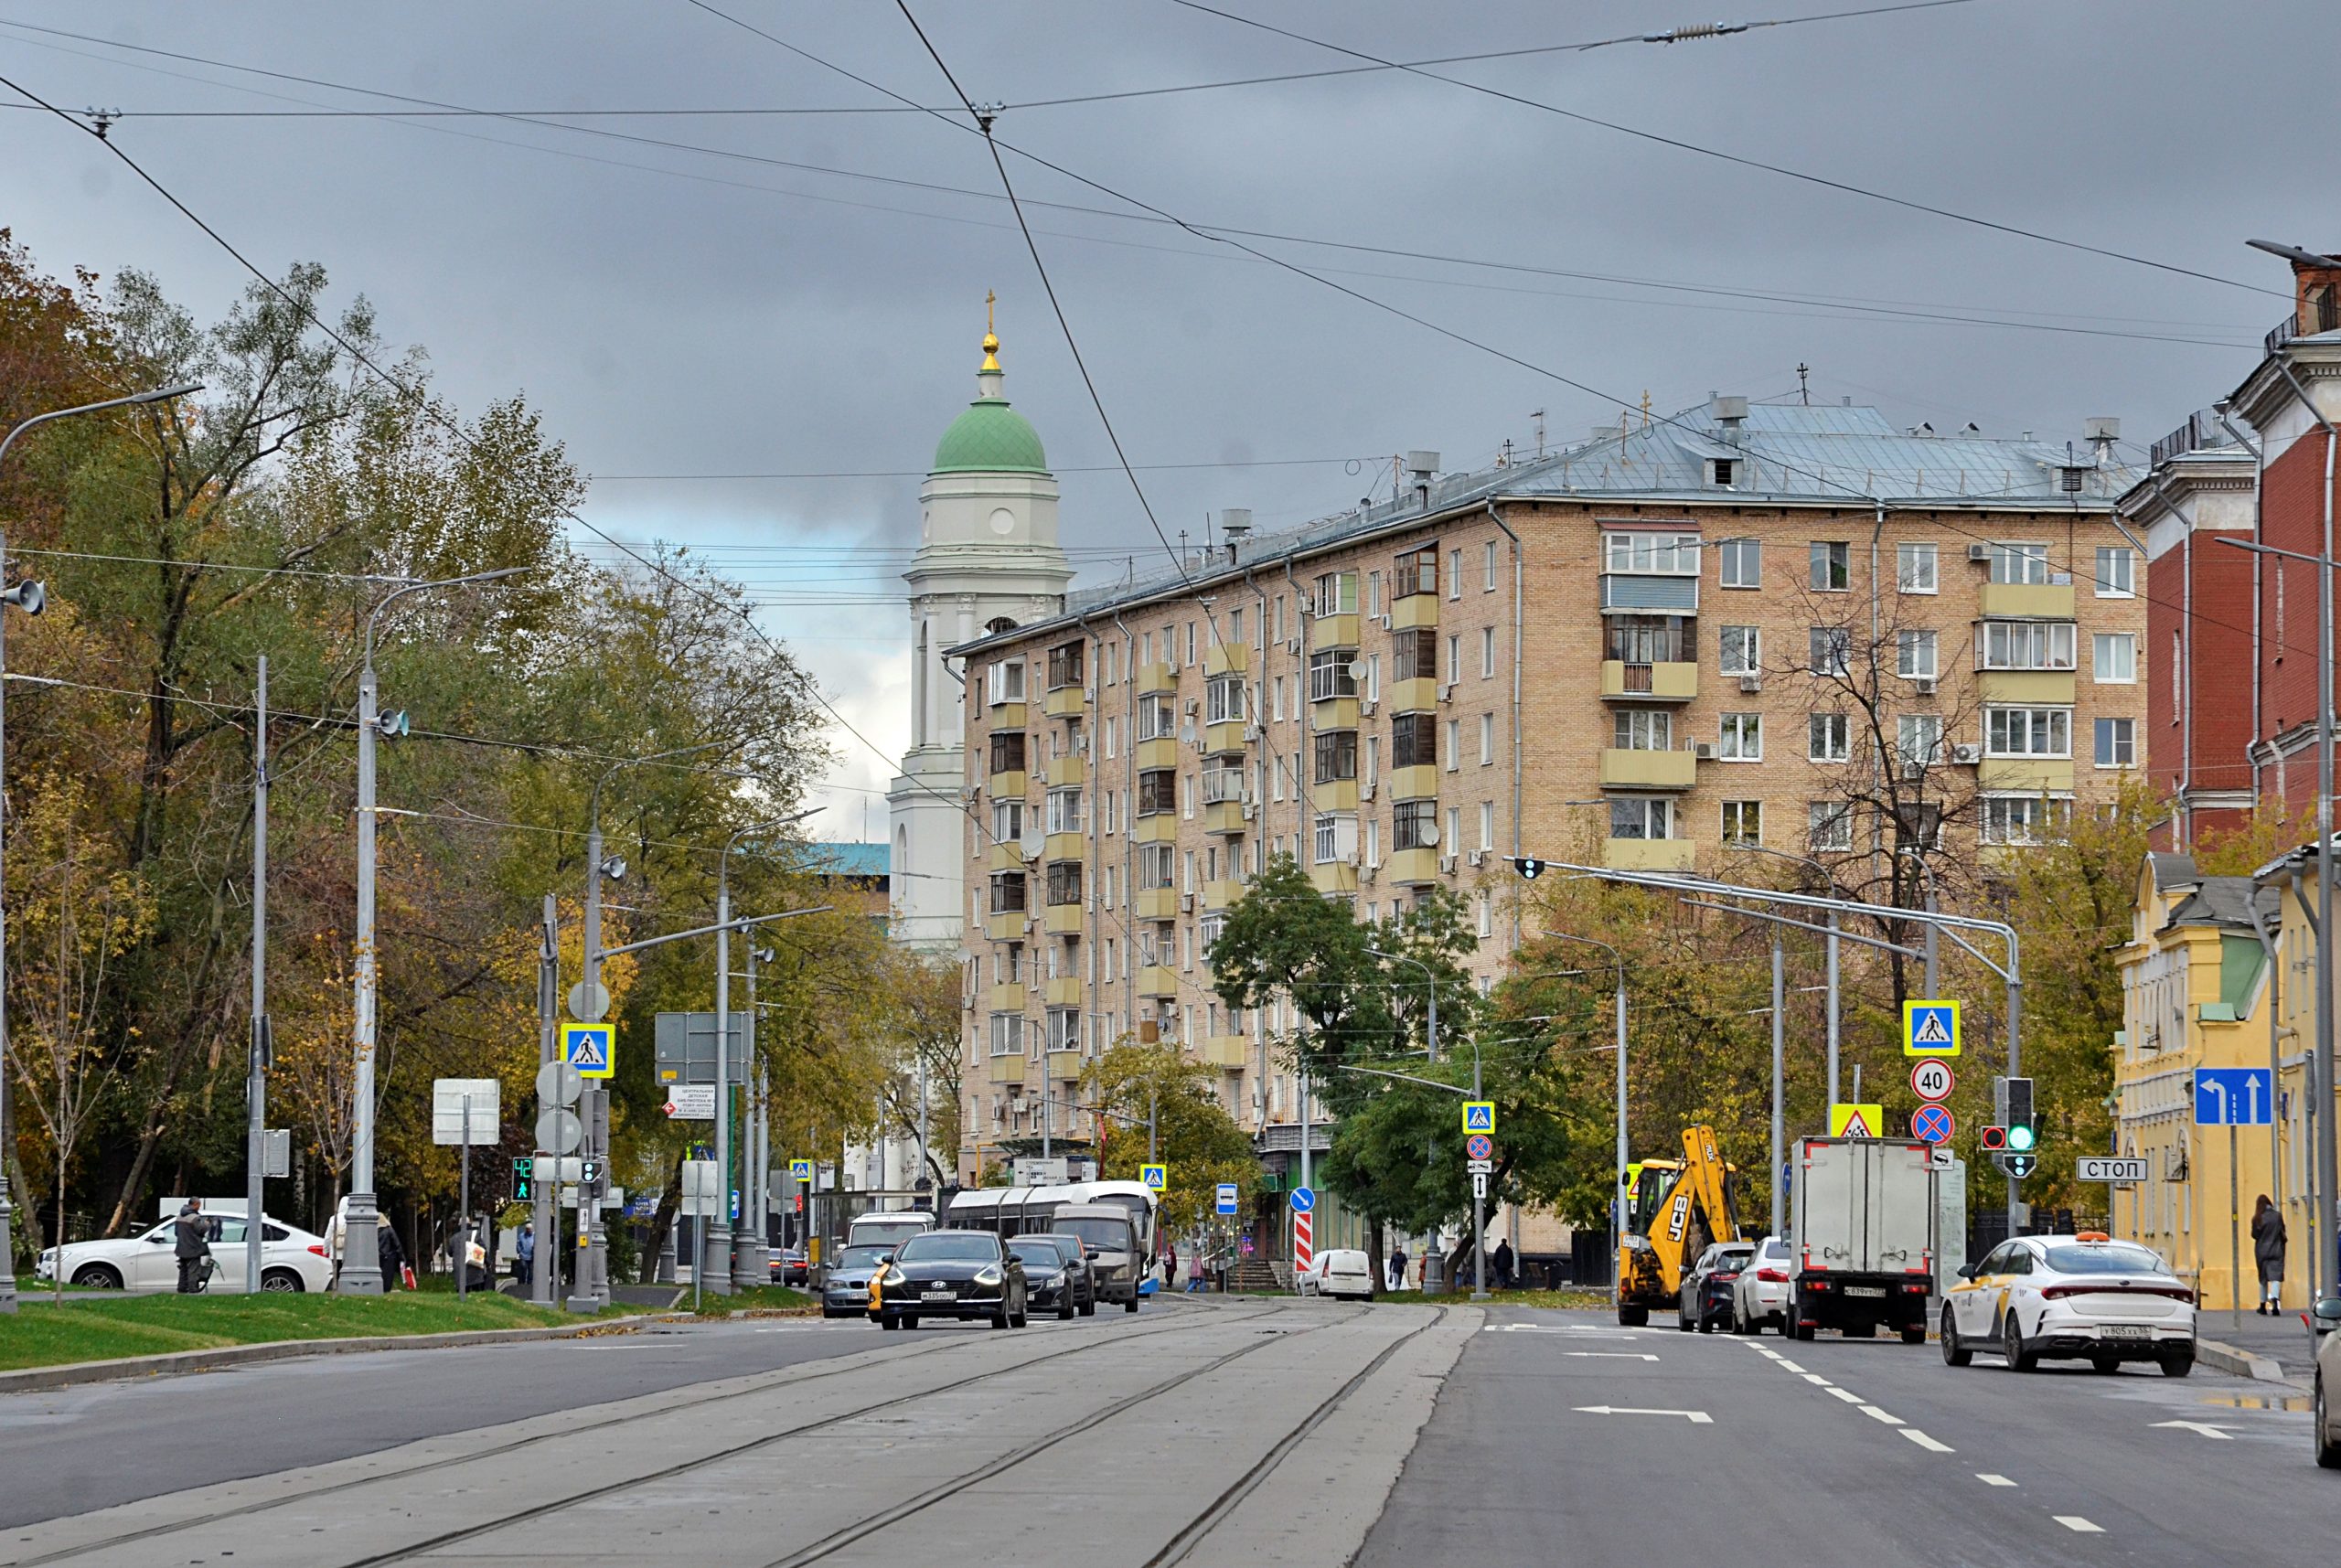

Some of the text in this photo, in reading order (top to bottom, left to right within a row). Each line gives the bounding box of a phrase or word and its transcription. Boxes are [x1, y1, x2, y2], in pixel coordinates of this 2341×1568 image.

[1921, 1072, 1942, 1090] 40
[514, 1159, 532, 1178] 42
[2087, 1161, 2139, 1178] СТОП
[1668, 1195, 1689, 1242] JCB
